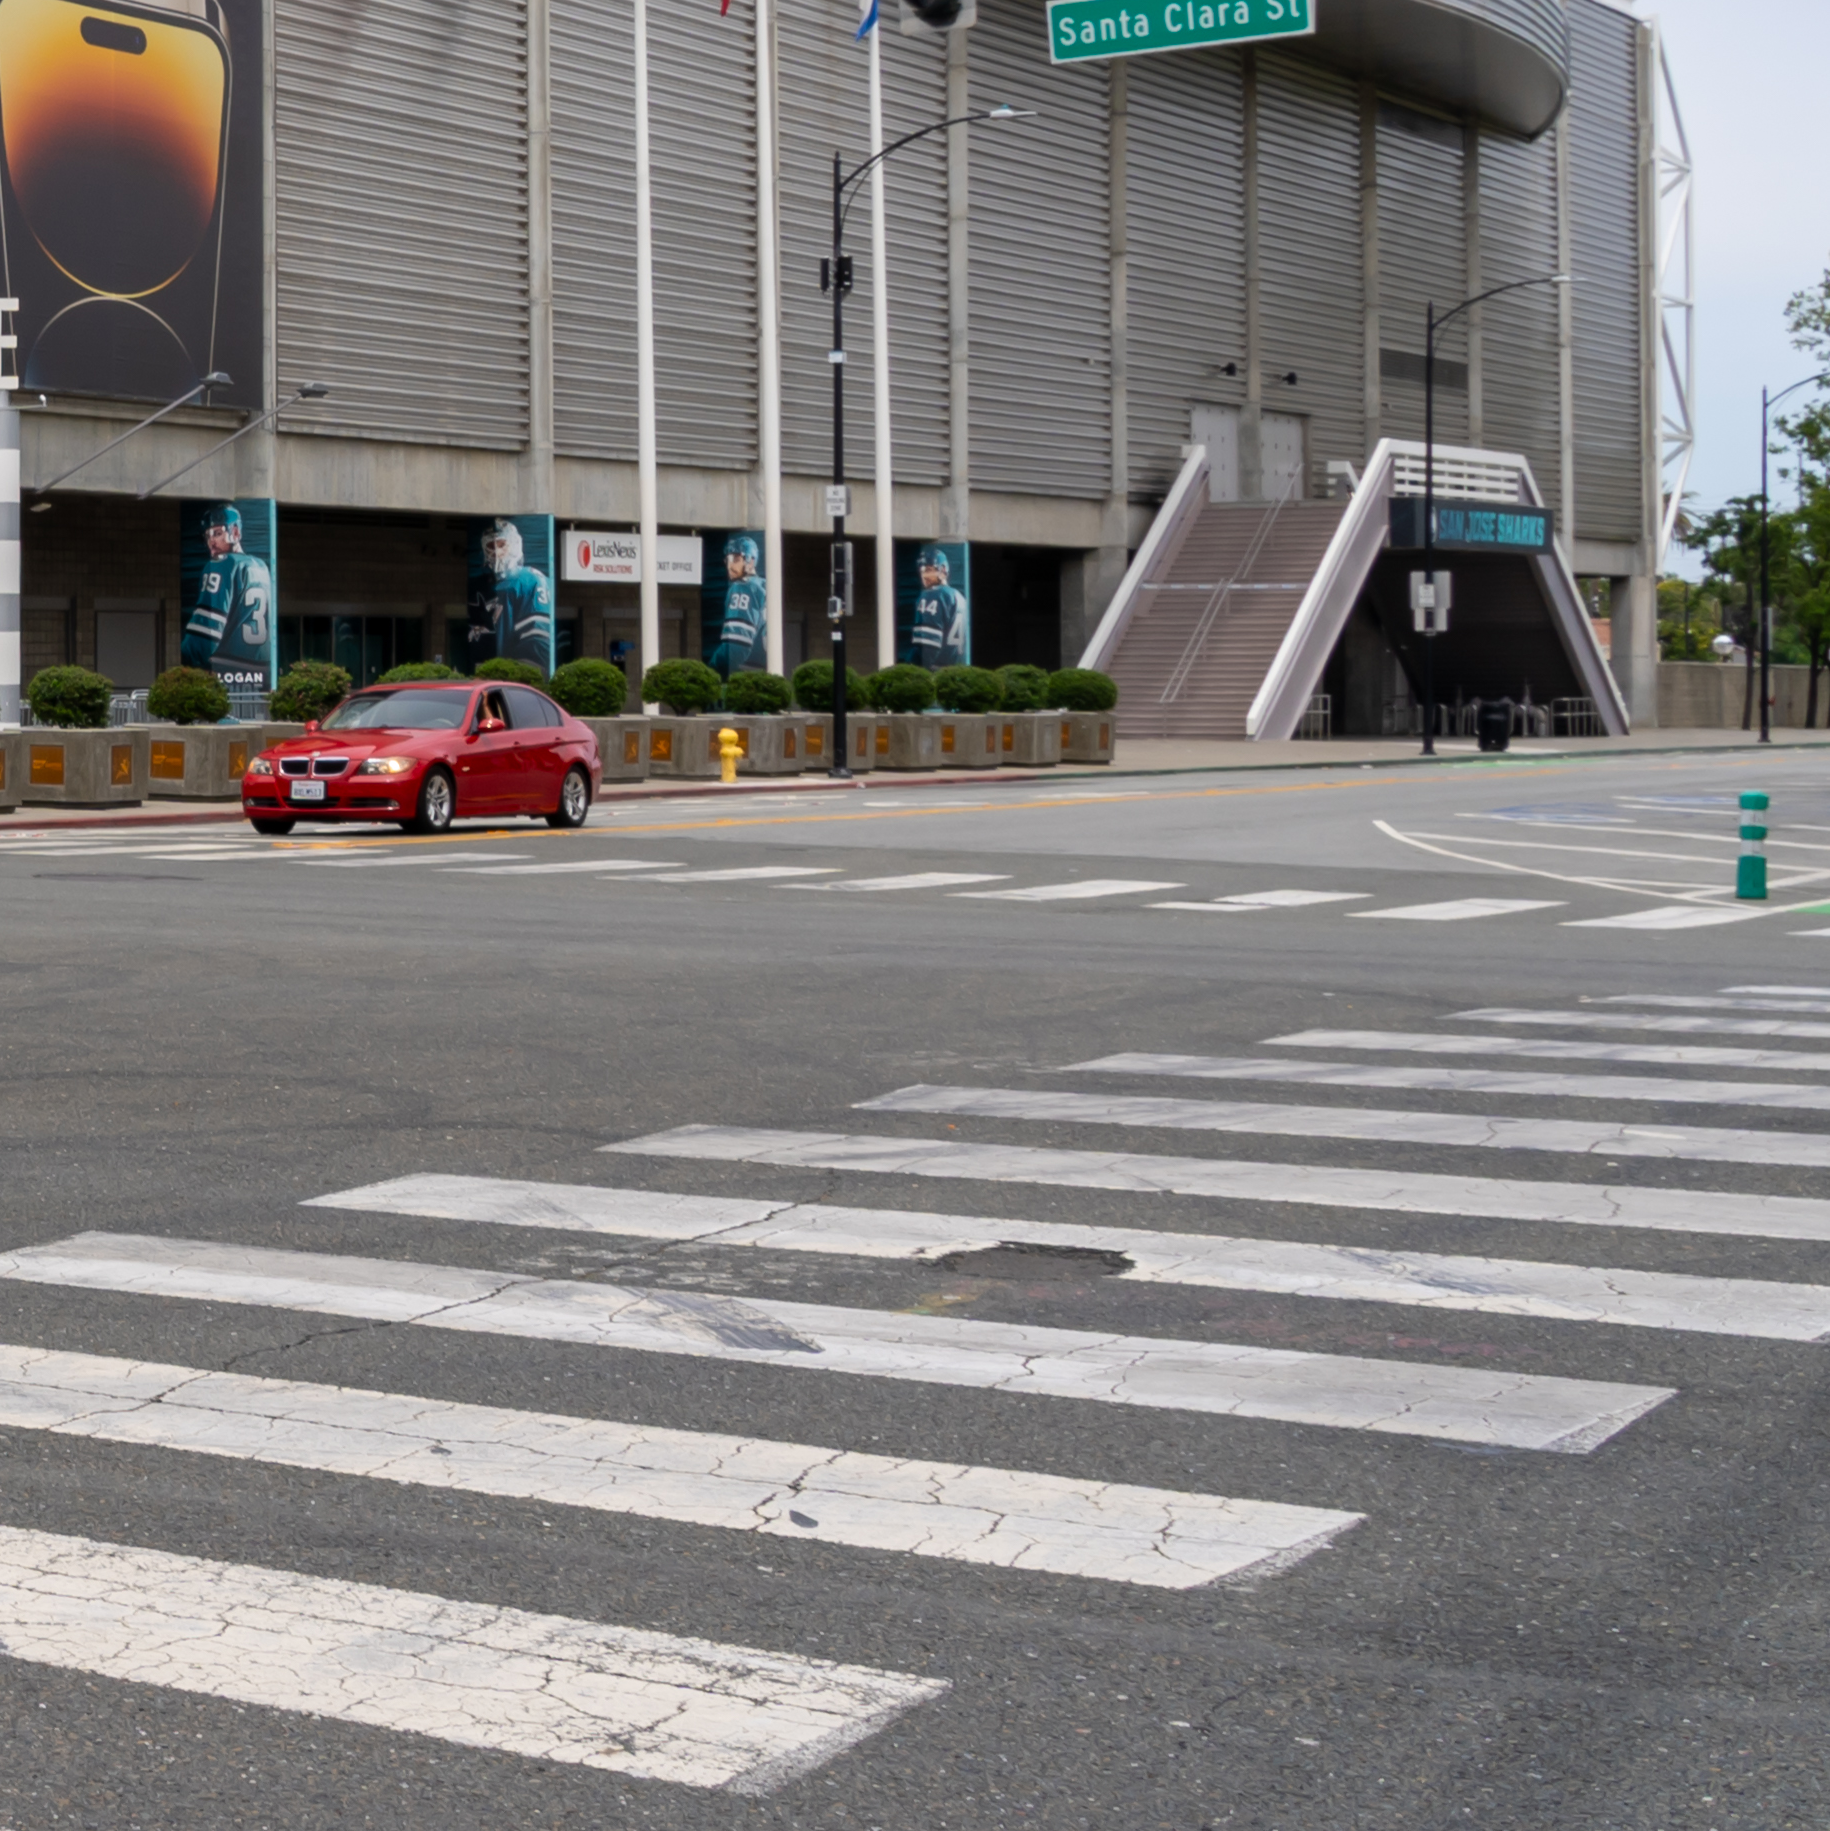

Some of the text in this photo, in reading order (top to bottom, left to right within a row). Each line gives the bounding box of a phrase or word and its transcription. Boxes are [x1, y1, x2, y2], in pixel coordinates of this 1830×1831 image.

[1059, 10, 1149, 45] Santa
[1165, 0, 1249, 32] Clara
[1439, 509, 1545, 546] SAN JOSE SHARKS
[592, 540, 637, 559] LexisNexis
[729, 593, 750, 610] 38
[917, 599, 938, 615] 44
[217, 672, 263, 684] LOGAN
